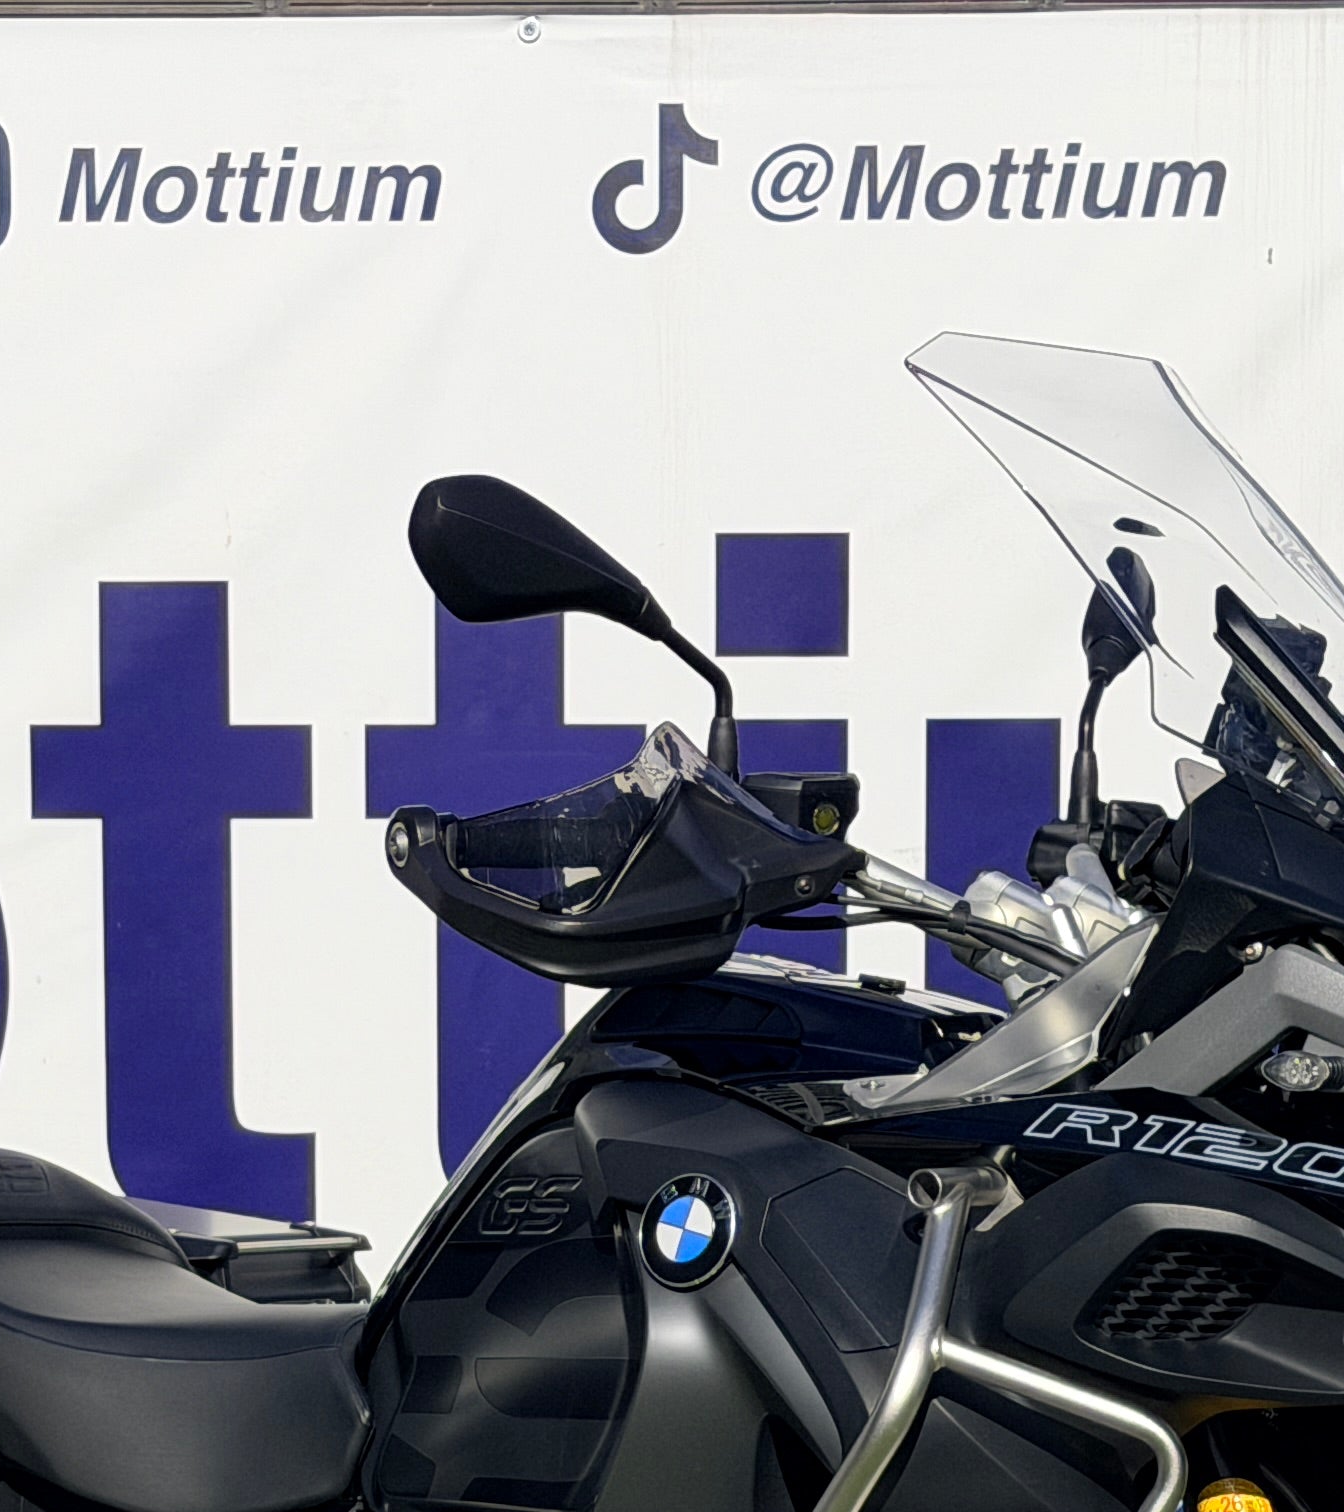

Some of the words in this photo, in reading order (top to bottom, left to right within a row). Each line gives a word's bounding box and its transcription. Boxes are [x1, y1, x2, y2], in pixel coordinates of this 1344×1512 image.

[59, 146, 442, 224] Mottium
[751, 142, 1228, 223] @Mottium
[479, 1176, 584, 1235] GS
